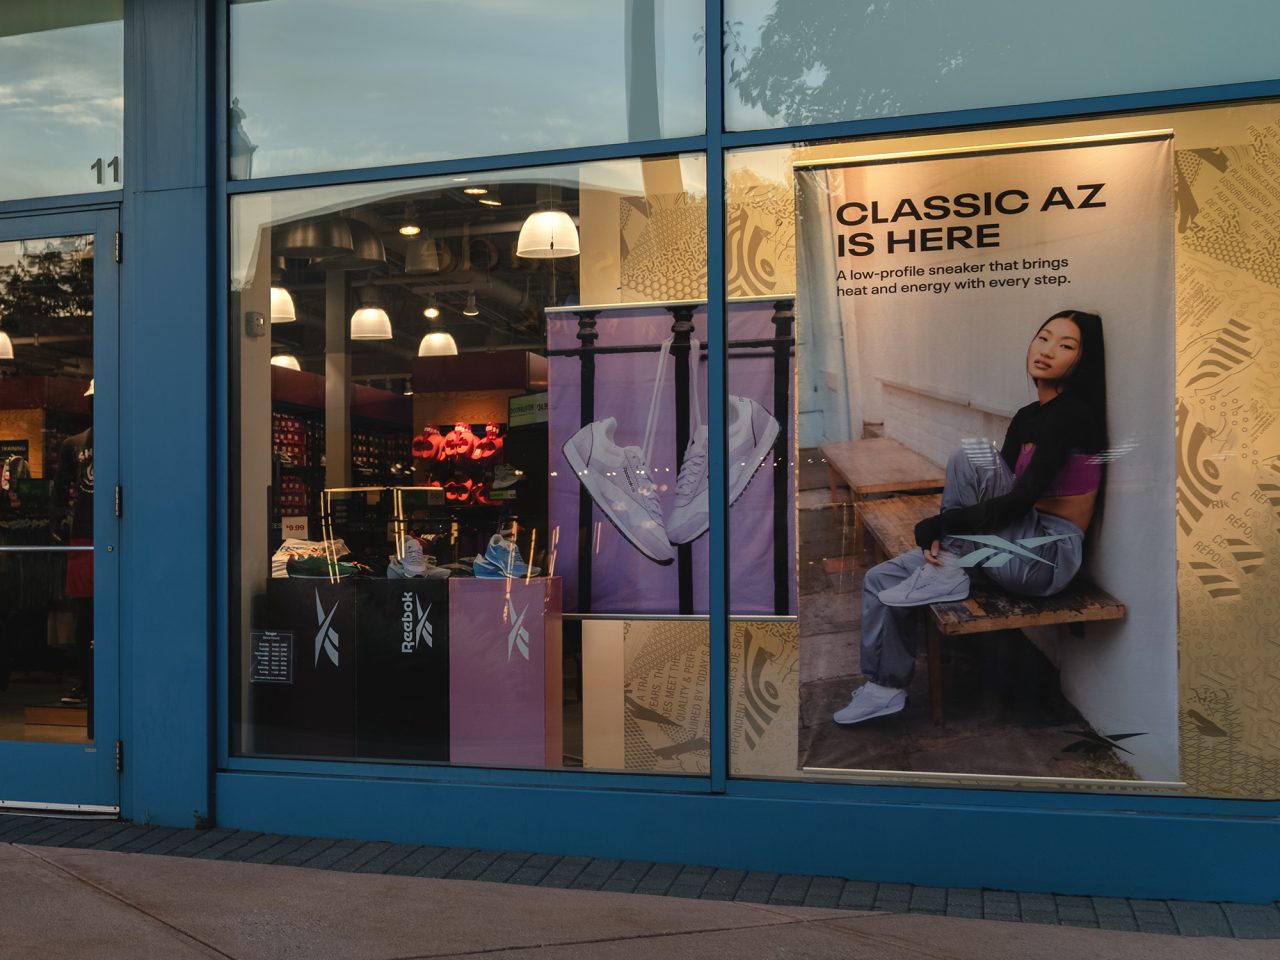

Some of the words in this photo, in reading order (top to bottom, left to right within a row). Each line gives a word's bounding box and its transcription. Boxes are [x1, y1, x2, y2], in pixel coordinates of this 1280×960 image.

[90, 156, 120, 185] 11
[836, 189, 1030, 227] CLASSIC
[1040, 183, 1107, 212] AZ
[837, 232, 875, 257] IS
[887, 223, 1000, 254] HERE
[836, 270, 847, 281] A
[850, 265, 925, 282] low-profile
[928, 262, 986, 276] sneaker
[989, 259, 1019, 272] that
[1023, 257, 1069, 272] brings
[836, 285, 868, 297] heat
[871, 282, 897, 295] and
[901, 279, 950, 295] energy
[954, 276, 986, 290] with
[989, 275, 1030, 289] every
[1034, 272, 1071, 287] step.
[402, 592, 413, 653] Reebok
[677, 686, 691, 722] QUALITY
